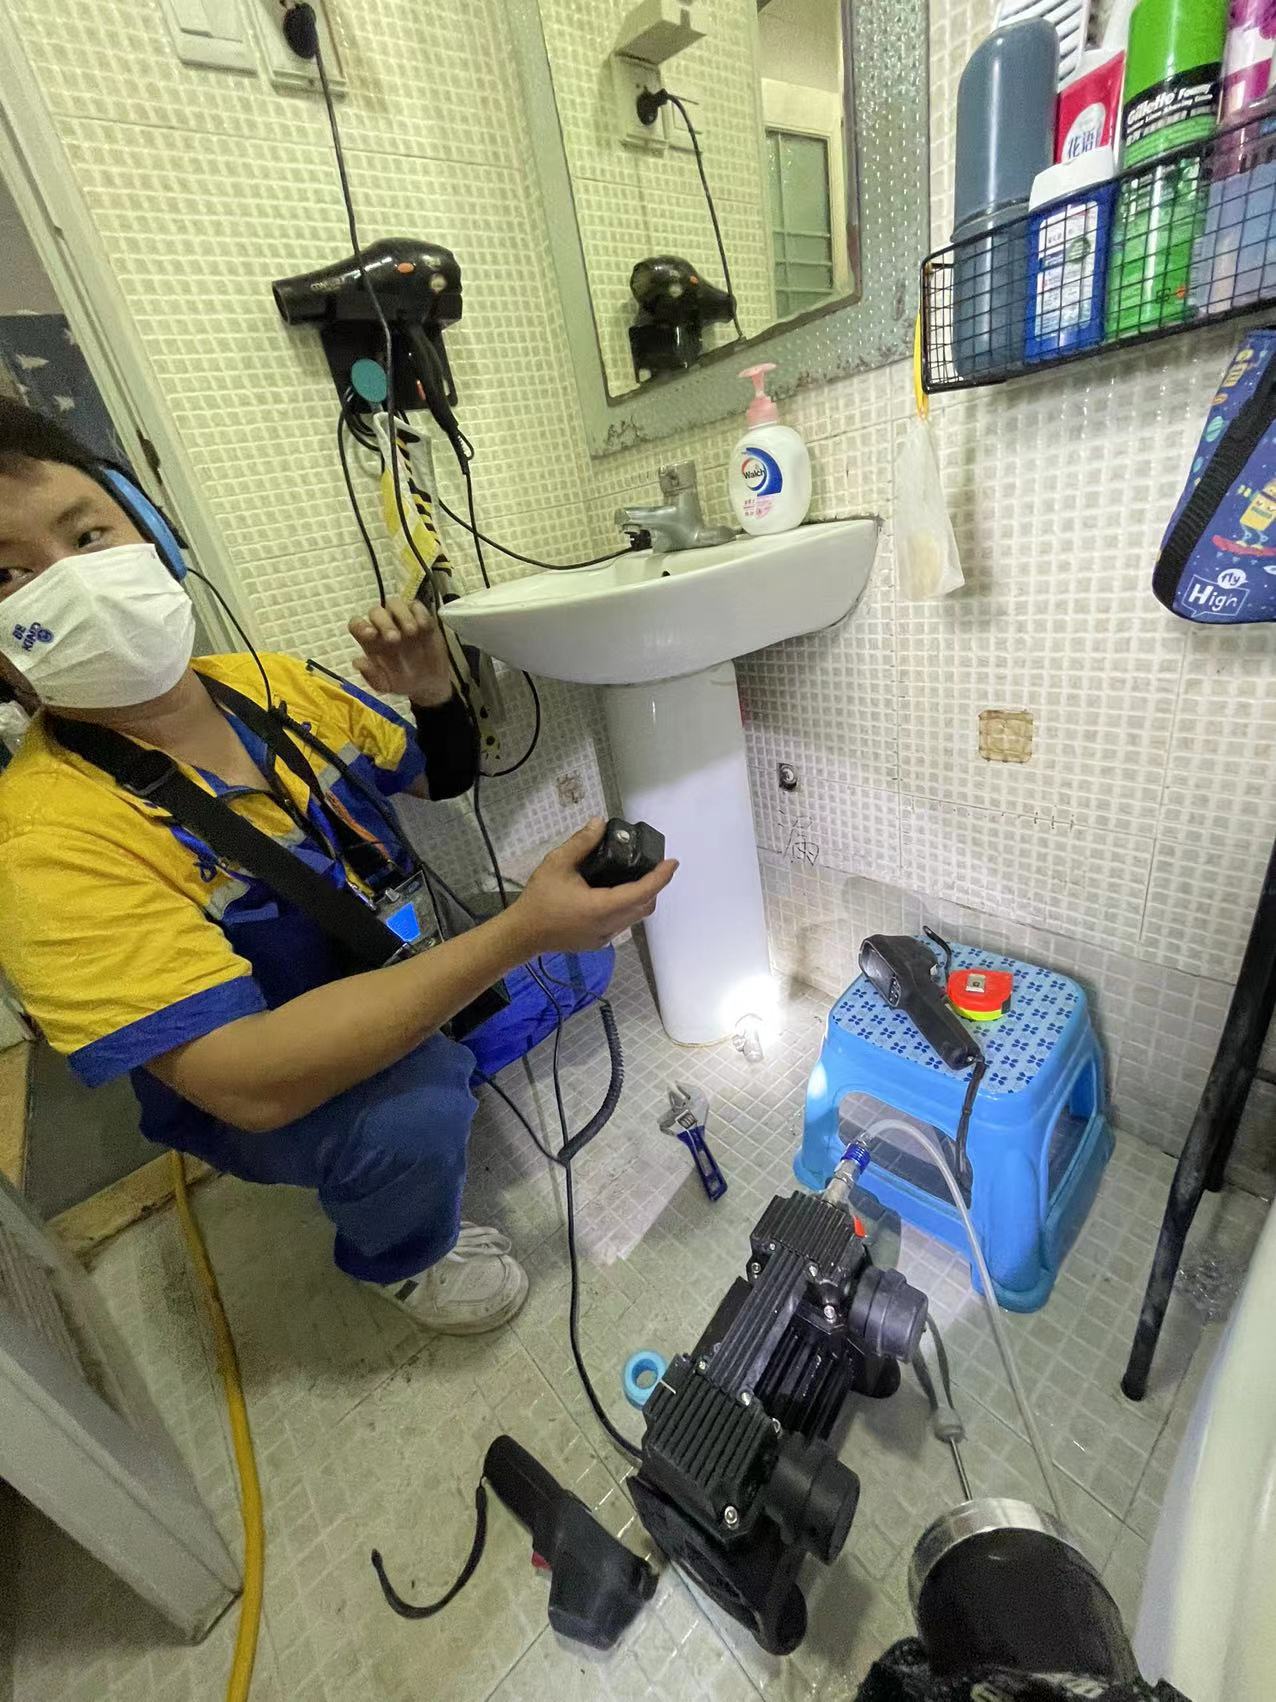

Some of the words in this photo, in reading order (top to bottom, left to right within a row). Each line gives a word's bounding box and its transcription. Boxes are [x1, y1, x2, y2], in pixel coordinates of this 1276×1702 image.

[1127, 91, 1176, 125] Gillette
[743, 468, 765, 480] Walch
[12, 624, 26, 640] BE
[22, 622, 41, 652] KIND
